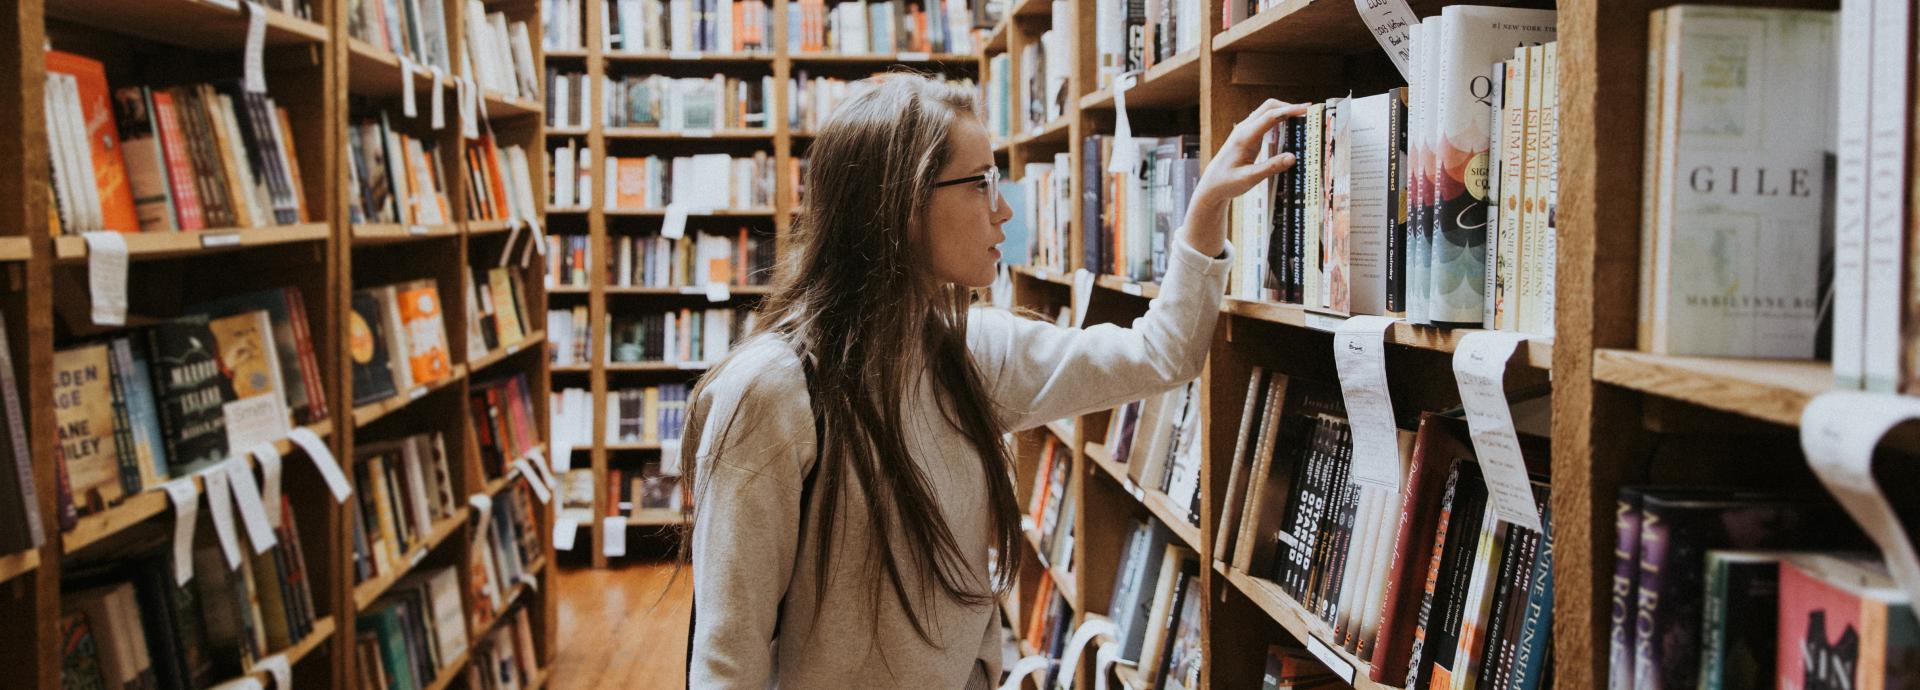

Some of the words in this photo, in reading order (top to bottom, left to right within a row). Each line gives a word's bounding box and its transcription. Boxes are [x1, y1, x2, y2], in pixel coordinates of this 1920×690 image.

[1469, 75, 1493, 107] Q
[1294, 124, 1302, 148] LOVE
[1389, 97, 1398, 164] Monument
[1509, 106, 1522, 181] ISHMAEL
[1524, 108, 1538, 186] ISHMAEL
[1538, 105, 1552, 182] ISHMAEL
[1389, 164, 1397, 191] Road
[1690, 165, 1811, 198] GILE
[1292, 207, 1300, 254] MATTHEW
[1487, 217, 1495, 244] Anna
[1506, 217, 1516, 256] DANIEL
[1522, 220, 1532, 258] DANIEL
[1535, 219, 1545, 259] DANIEL
[1483, 246, 1494, 299] Quindlen
[1504, 257, 1514, 293] QUINN
[1520, 261, 1530, 297] QUINN
[1533, 261, 1543, 298] QUINN
[1338, 444, 1346, 459] THE
[1343, 447, 1352, 461] THE
[1324, 459, 1343, 520] IMPERFECTIONISTS
[1329, 462, 1349, 524] IMPERFECTIONISTS
[1404, 461, 1419, 495] Devil
[1294, 492, 1317, 566] OTARED
[1300, 495, 1324, 571] OTARED
[1518, 532, 1530, 555] WHY
[1501, 542, 1517, 579] RAKHA
[1527, 536, 1538, 559] WHY
[1451, 569, 1460, 584] Story
[1458, 572, 1468, 591] Story
[1511, 563, 1524, 588] CAME
[1519, 566, 1533, 593] CAME
[1441, 598, 1454, 633] Childhood
[1449, 603, 1461, 637] Childhood
[1495, 599, 1504, 615] the
[1480, 615, 1501, 682] CROCODILES
